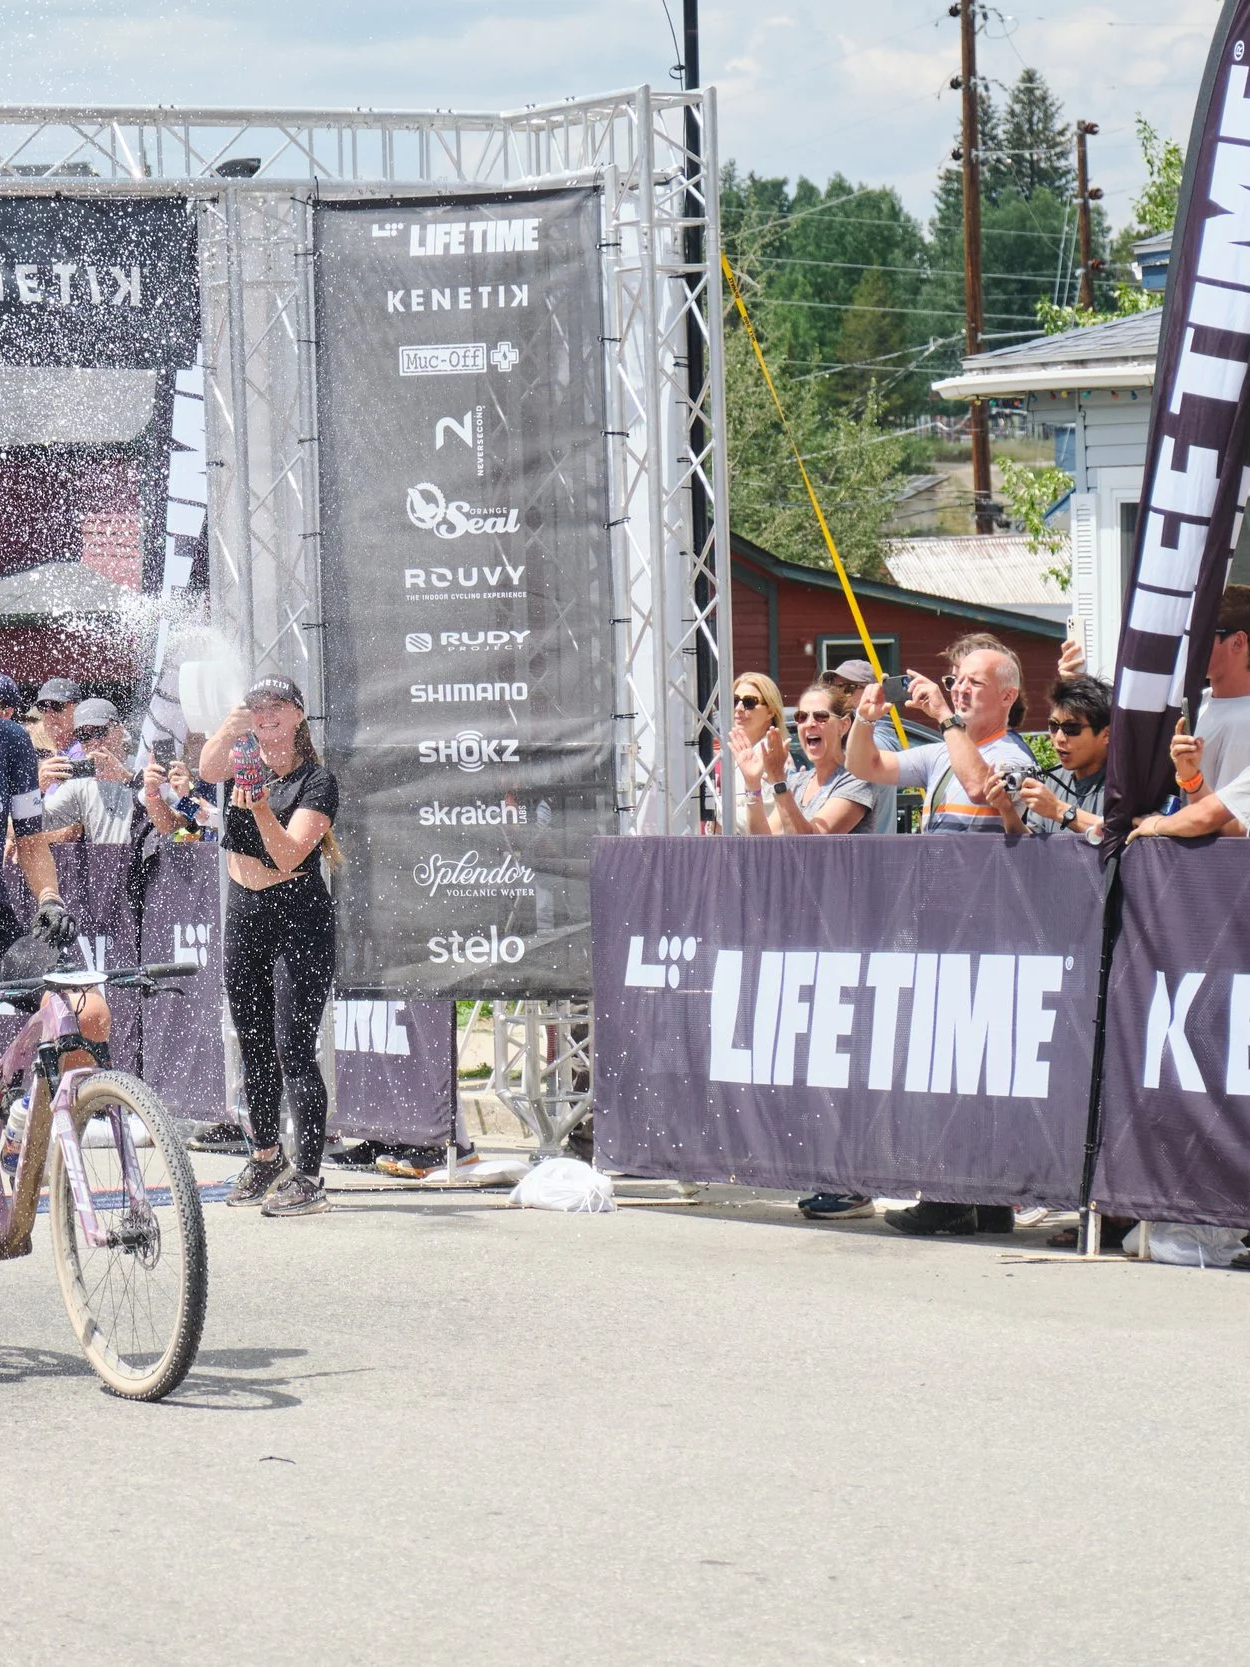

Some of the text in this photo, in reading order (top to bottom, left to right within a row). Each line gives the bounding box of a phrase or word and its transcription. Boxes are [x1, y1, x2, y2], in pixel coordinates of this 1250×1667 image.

[387, 284, 529, 313] KENETIK
[405, 349, 482, 370] Muc-Off
[476, 405, 484, 477] NEVERSECOND
[434, 501, 520, 539] Seal
[469, 507, 508, 515] ORANGE
[404, 565, 526, 589] ROUVY
[451, 592, 481, 600] CYCLING
[483, 591, 527, 599] EXPERIENCE
[440, 630, 531, 646] RUDY
[448, 644, 524, 652] PROJECT
[410, 682, 528, 703] SHIMANO
[418, 739, 520, 763] SHOKZ
[419, 800, 518, 826] skratch
[518, 804, 527, 825] LABS
[413, 850, 535, 897] Splendor
[446, 887, 535, 898] VOLCANIC WATER
[428, 925, 525, 964] stelo
